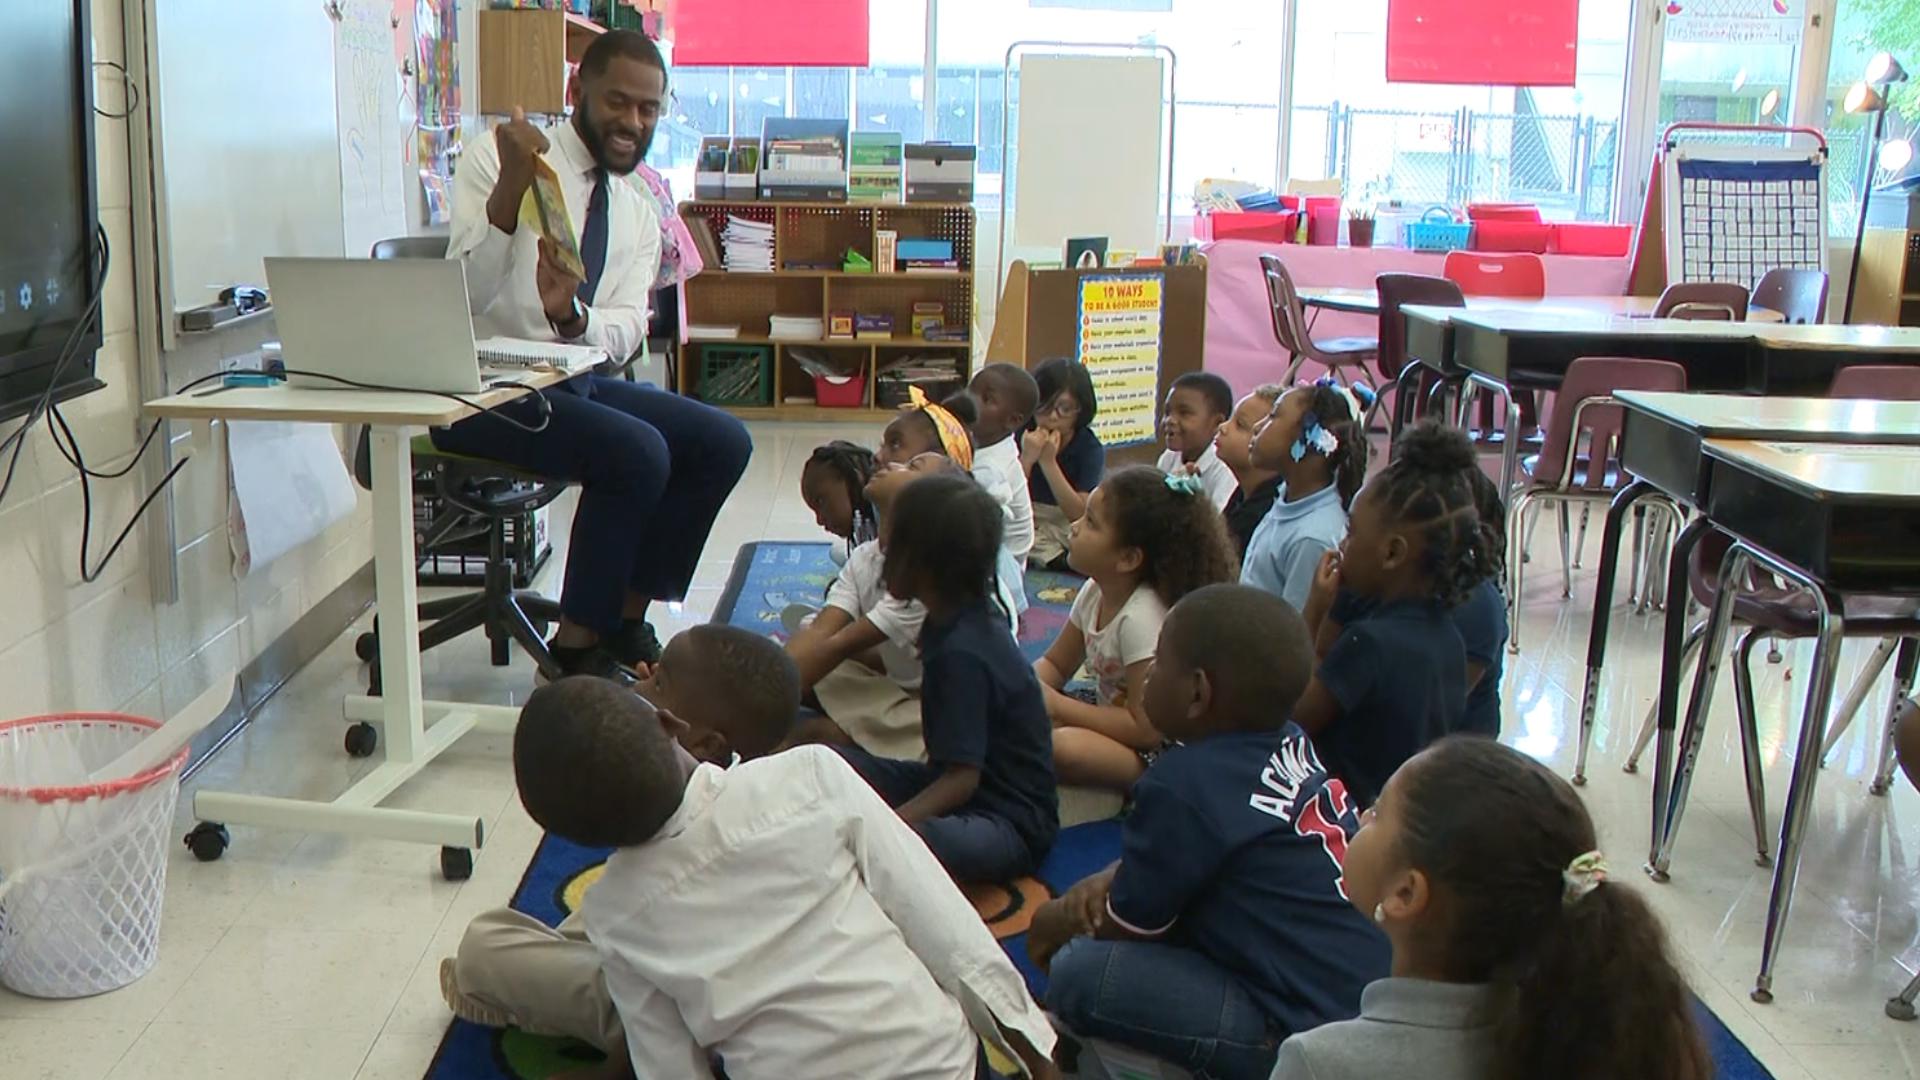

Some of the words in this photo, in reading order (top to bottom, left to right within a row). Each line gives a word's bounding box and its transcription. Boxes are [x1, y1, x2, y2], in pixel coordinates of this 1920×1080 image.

[1103, 286, 1115, 298] 10
[1117, 284, 1143, 297] WAYS
[1085, 302, 1094, 311] TO
[1096, 302, 1104, 310] BE
[1113, 301, 1130, 310] GOOD
[1132, 299, 1159, 308] STUDENT
